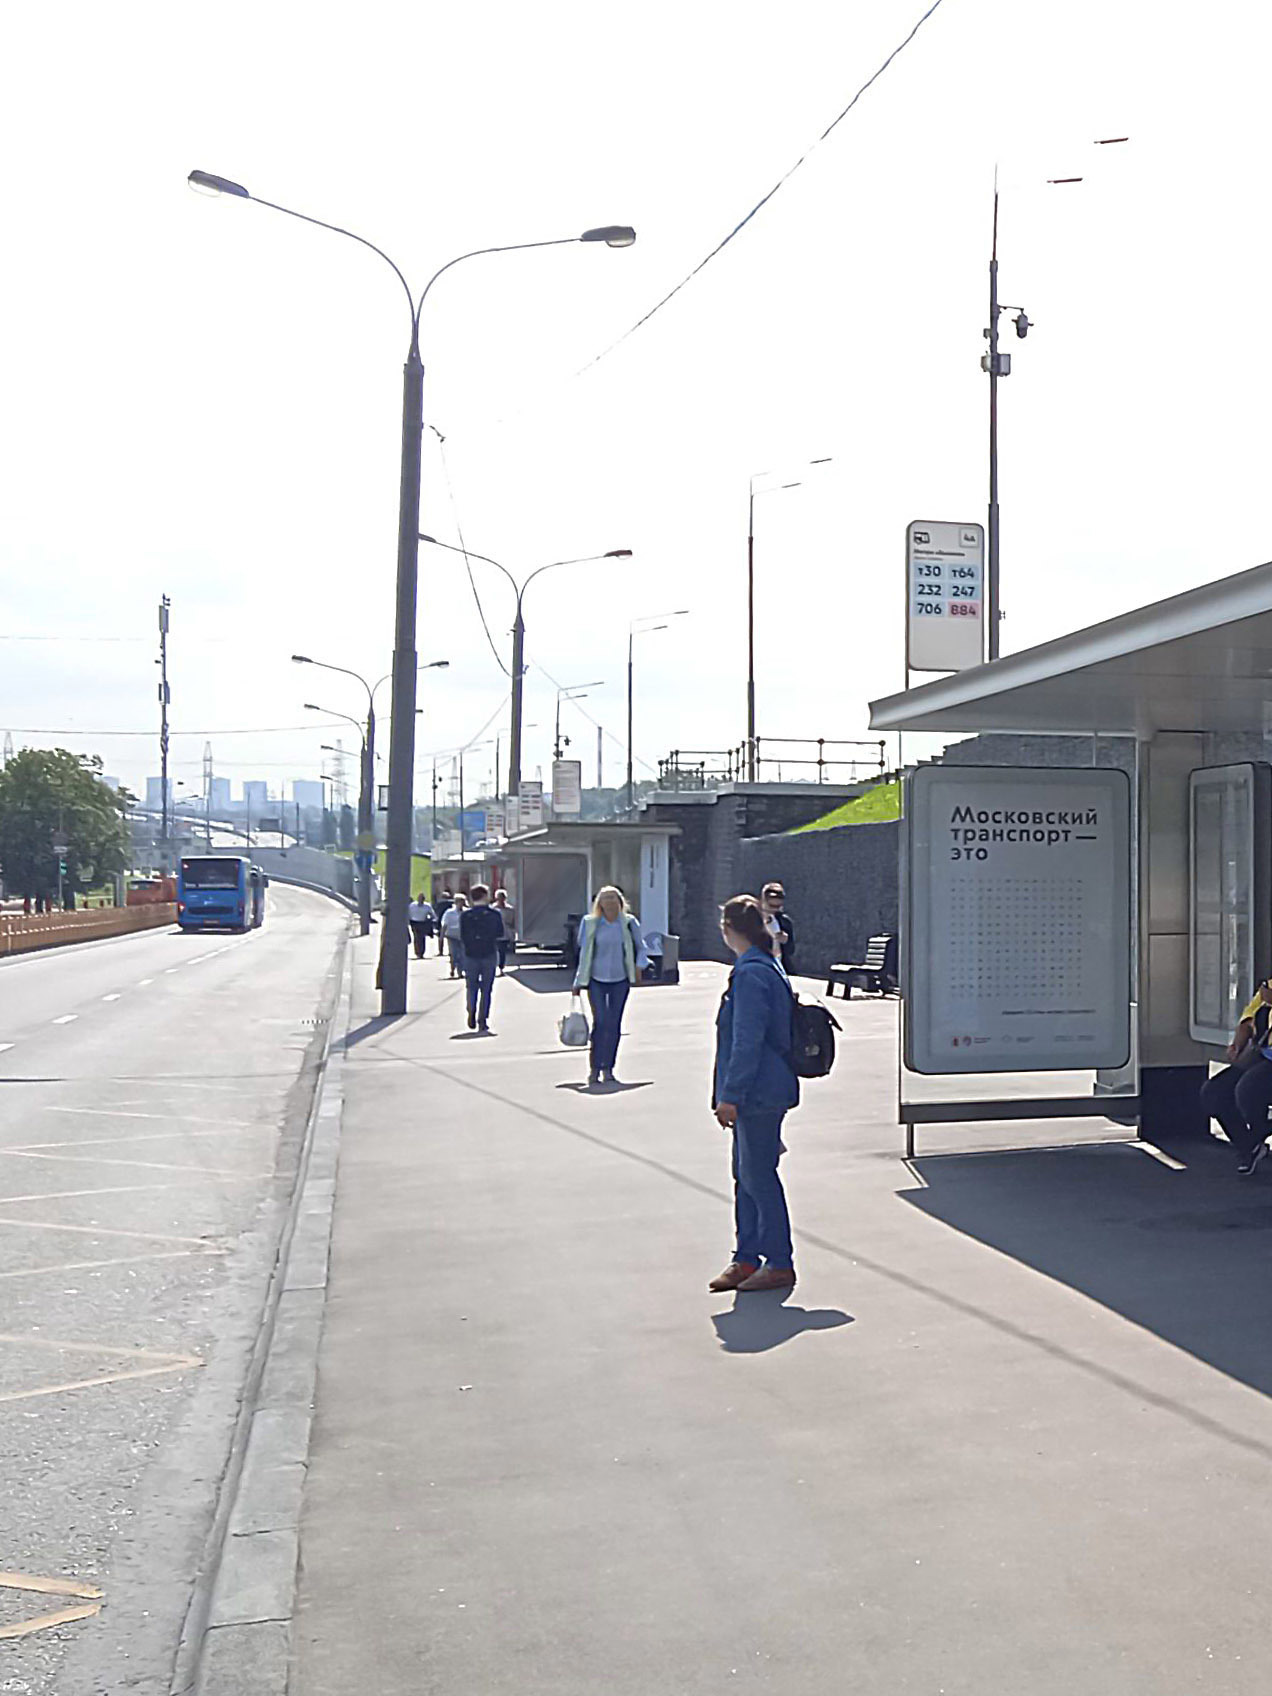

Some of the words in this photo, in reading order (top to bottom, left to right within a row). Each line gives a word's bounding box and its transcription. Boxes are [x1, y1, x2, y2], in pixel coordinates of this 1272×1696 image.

[917, 584, 941, 596] 232
[951, 586, 975, 597] 247
[917, 603, 942, 614] 706
[950, 604, 976, 616] 884
[951, 806, 1098, 825] Московский
[951, 828, 1071, 846] транспорт
[951, 847, 988, 861] это
